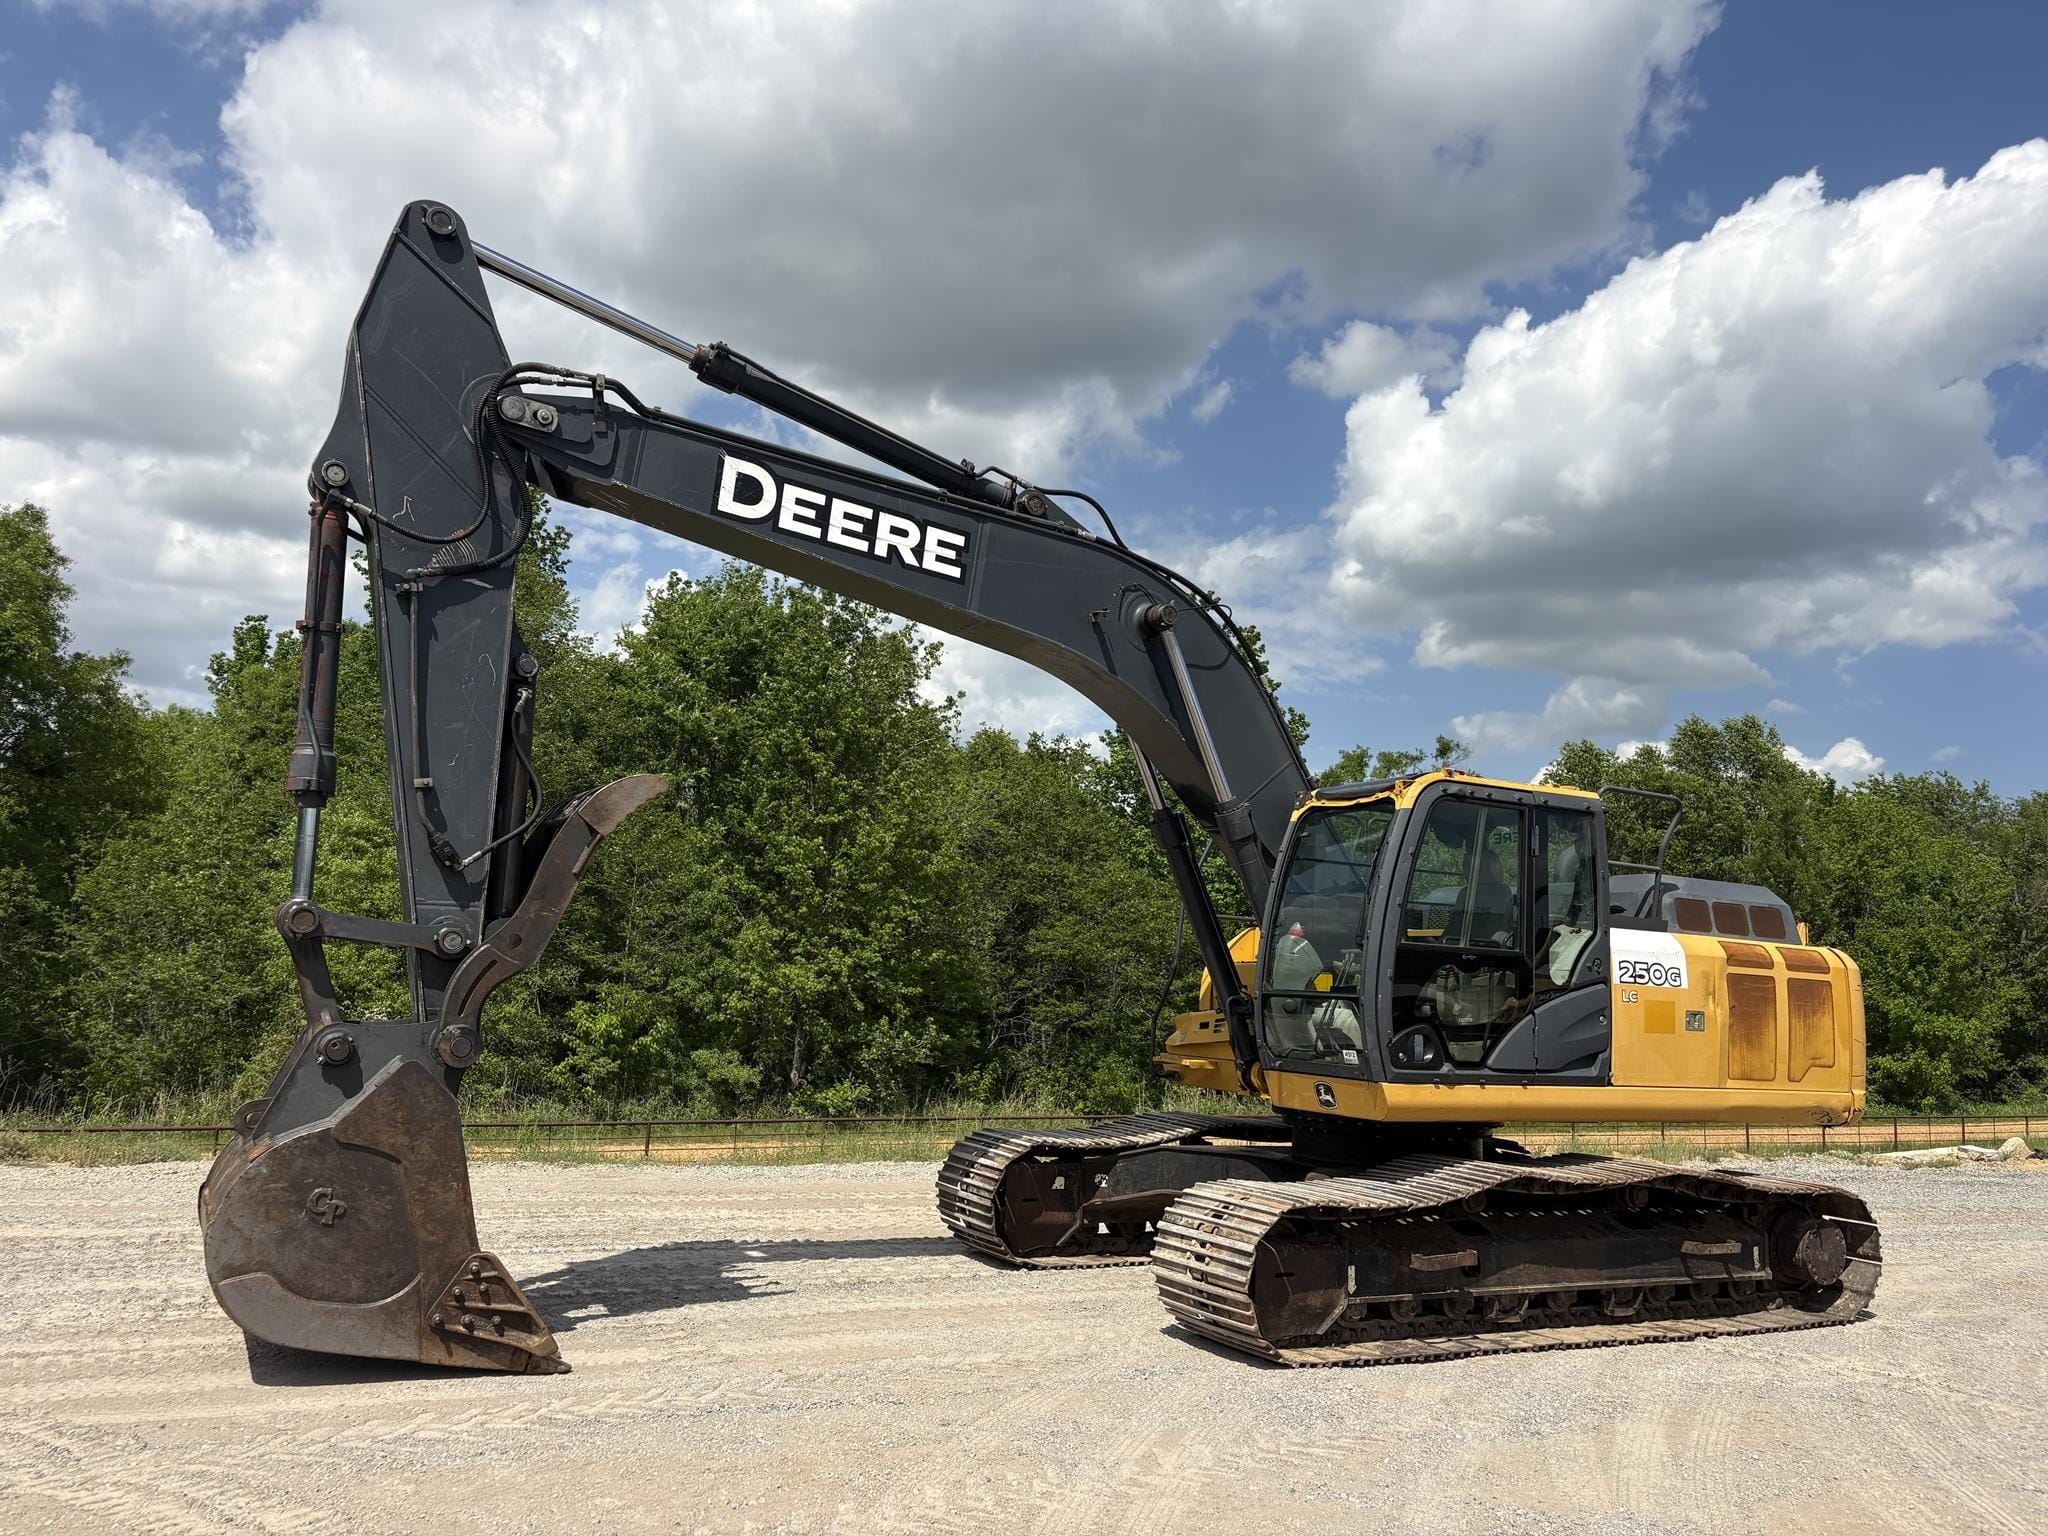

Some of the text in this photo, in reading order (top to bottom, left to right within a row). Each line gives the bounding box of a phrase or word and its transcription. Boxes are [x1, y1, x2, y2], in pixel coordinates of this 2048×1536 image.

[717, 455, 966, 579] DEERE
[1619, 960, 1681, 987] 250G
[1622, 989, 1638, 1003] LC
